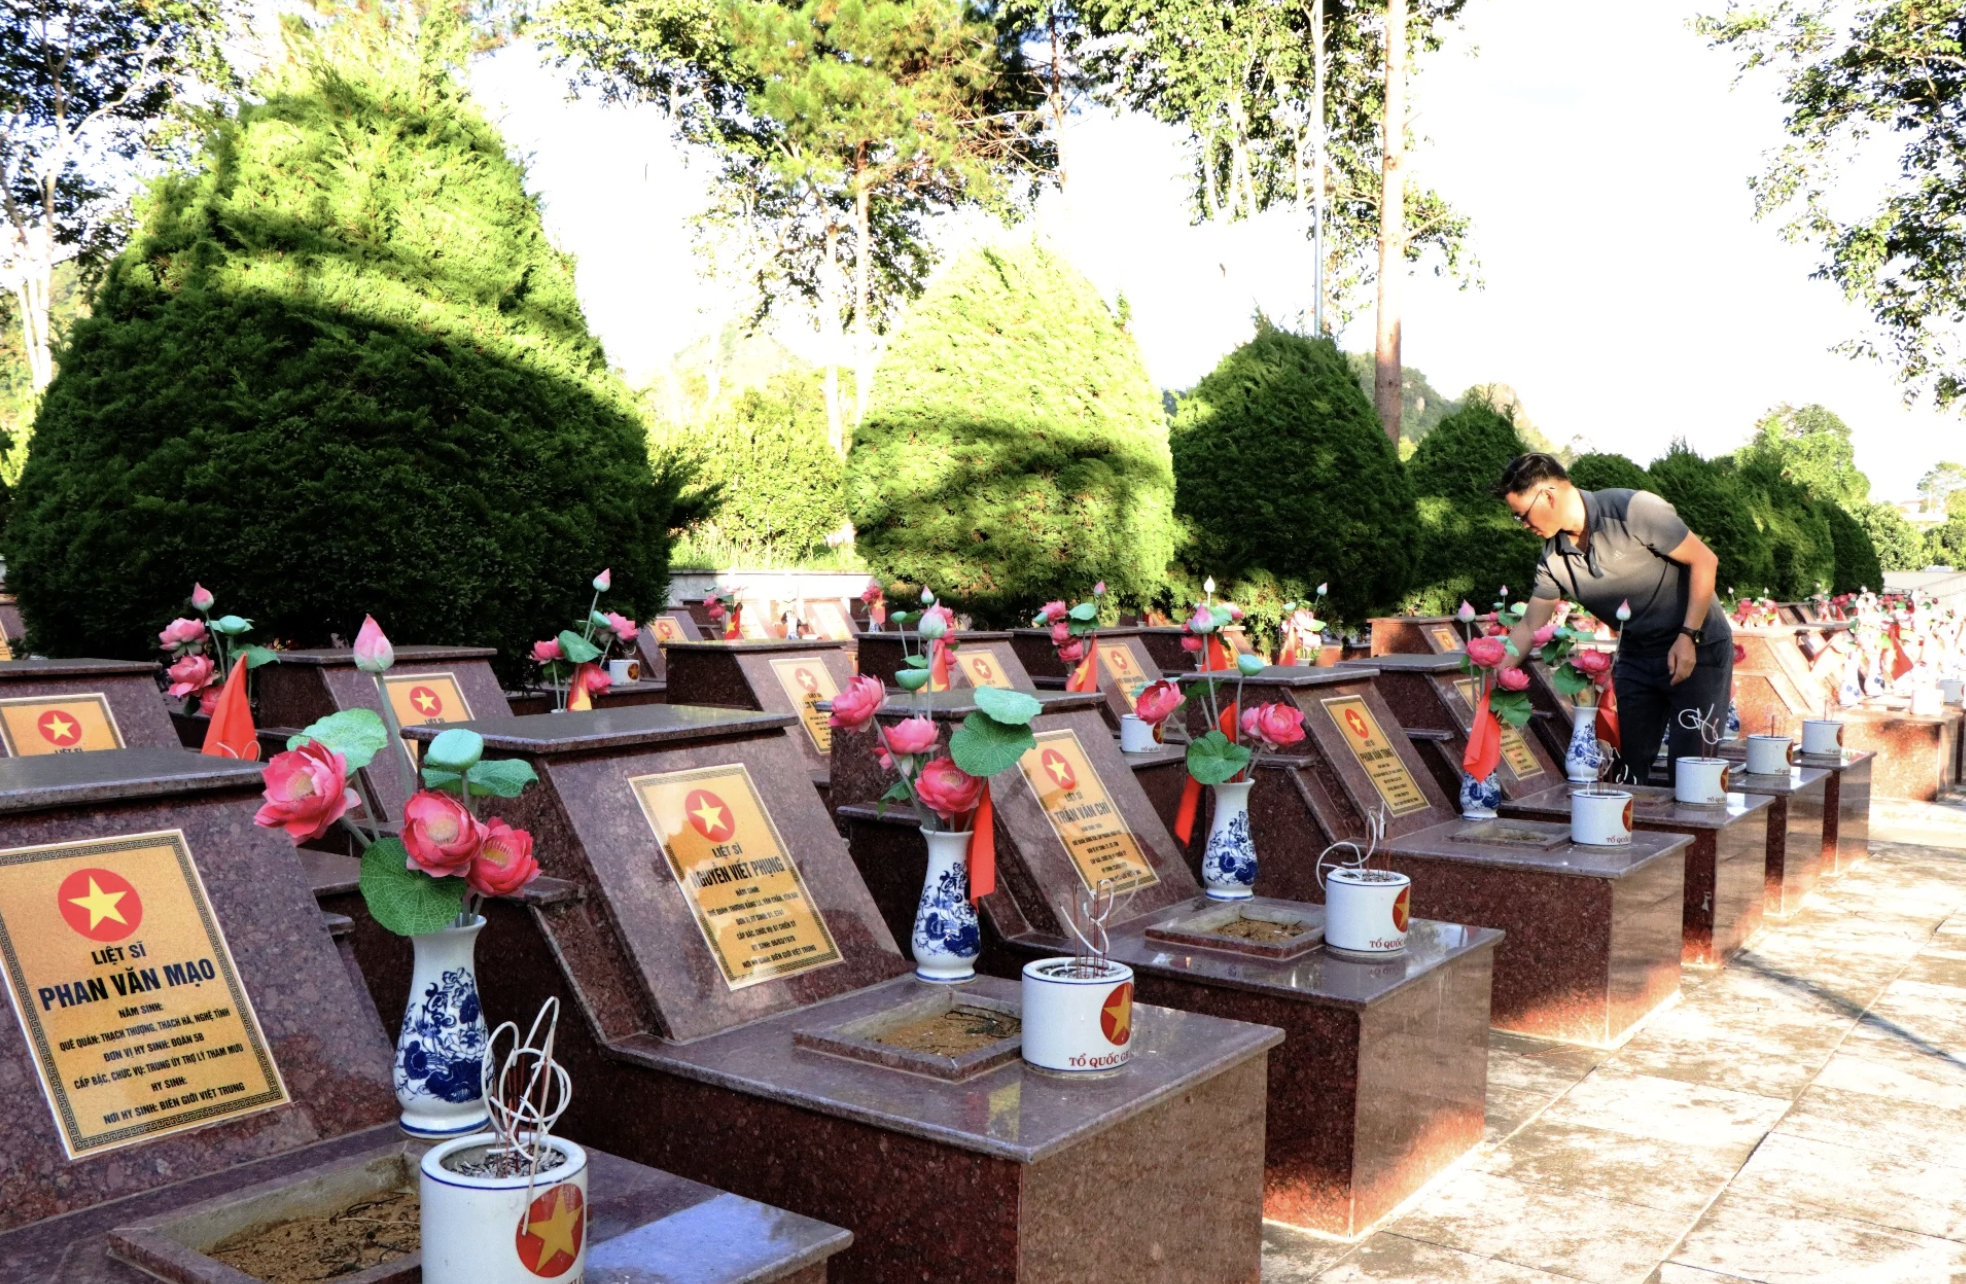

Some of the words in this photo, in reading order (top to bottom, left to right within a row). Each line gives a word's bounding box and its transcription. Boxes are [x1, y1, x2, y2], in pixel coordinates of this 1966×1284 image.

[711, 845, 731, 859] LIỆT
[732, 842, 743, 855] SĨ
[728, 858, 752, 881] VIẾT
[750, 856, 785, 877] PHỤNG
[91, 945, 125, 965] LIỆT
[128, 941, 147, 959] SĨ
[37, 977, 109, 1011] PHAN
[110, 966, 161, 996] VĂN
[162, 958, 216, 987] MẠO
[118, 1005, 140, 1018] NĂM
[140, 1002, 164, 1014] SINH:
[59, 1038, 75, 1052] QUÊ
[100, 1028, 125, 1042] THẠCH
[157, 1018, 181, 1030] THẠCH
[103, 1050, 123, 1062] ĐƠN
[123, 1048, 134, 1058] VỊ
[133, 1045, 145, 1055] HY
[146, 1040, 171, 1052] SINH:
[170, 1035, 193, 1047] ĐOÀN
[1069, 1053, 1086, 1067] TỔ
[1089, 1052, 1119, 1068] QUỐC
[73, 1075, 90, 1089] CẤP
[146, 1060, 171, 1073] TRUNG
[206, 1046, 227, 1059] THAM
[150, 1081, 163, 1092] HY
[164, 1076, 188, 1088] SINH:
[103, 1112, 120, 1125] NƠI
[120, 1109, 133, 1120] HY
[134, 1103, 159, 1117] SINH:
[159, 1097, 181, 1111] BIÊN
[199, 1088, 217, 1101] VIỆT
[217, 1082, 246, 1096] TRUNG
